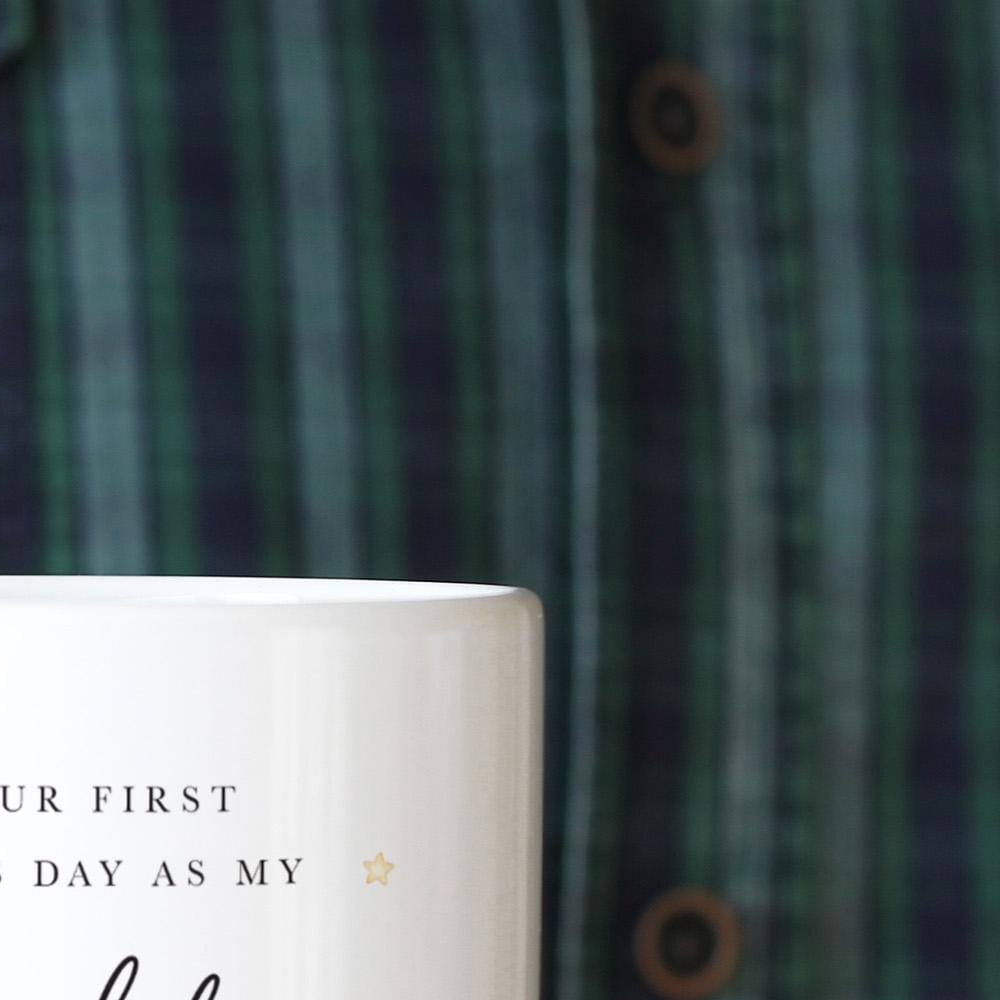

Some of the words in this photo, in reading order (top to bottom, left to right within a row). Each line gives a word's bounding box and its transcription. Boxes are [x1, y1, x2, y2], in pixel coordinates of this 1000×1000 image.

[93, 785, 238, 813] FIRST
[33, 860, 124, 887] DAY
[152, 860, 206, 887] AS
[236, 857, 305, 886] MY
